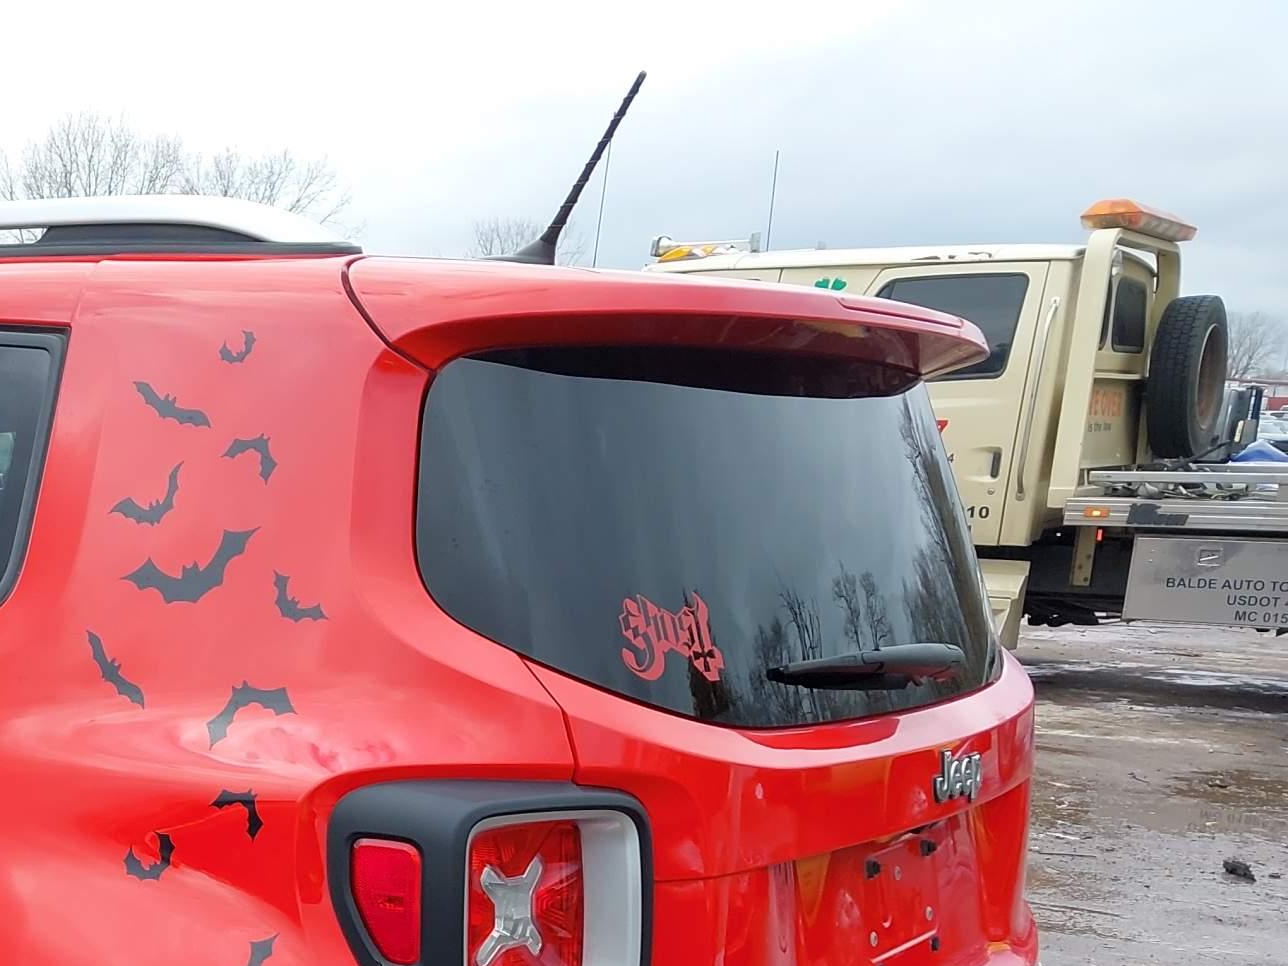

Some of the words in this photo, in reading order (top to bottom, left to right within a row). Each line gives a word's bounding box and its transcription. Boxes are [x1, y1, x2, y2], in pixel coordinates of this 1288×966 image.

[1166, 577, 1218, 590] BALDE
[1221, 579, 1265, 592] AUTO
[1227, 595, 1280, 607] USDOT
[1234, 610, 1258, 622] MC
[933, 750, 981, 803] Jeep
